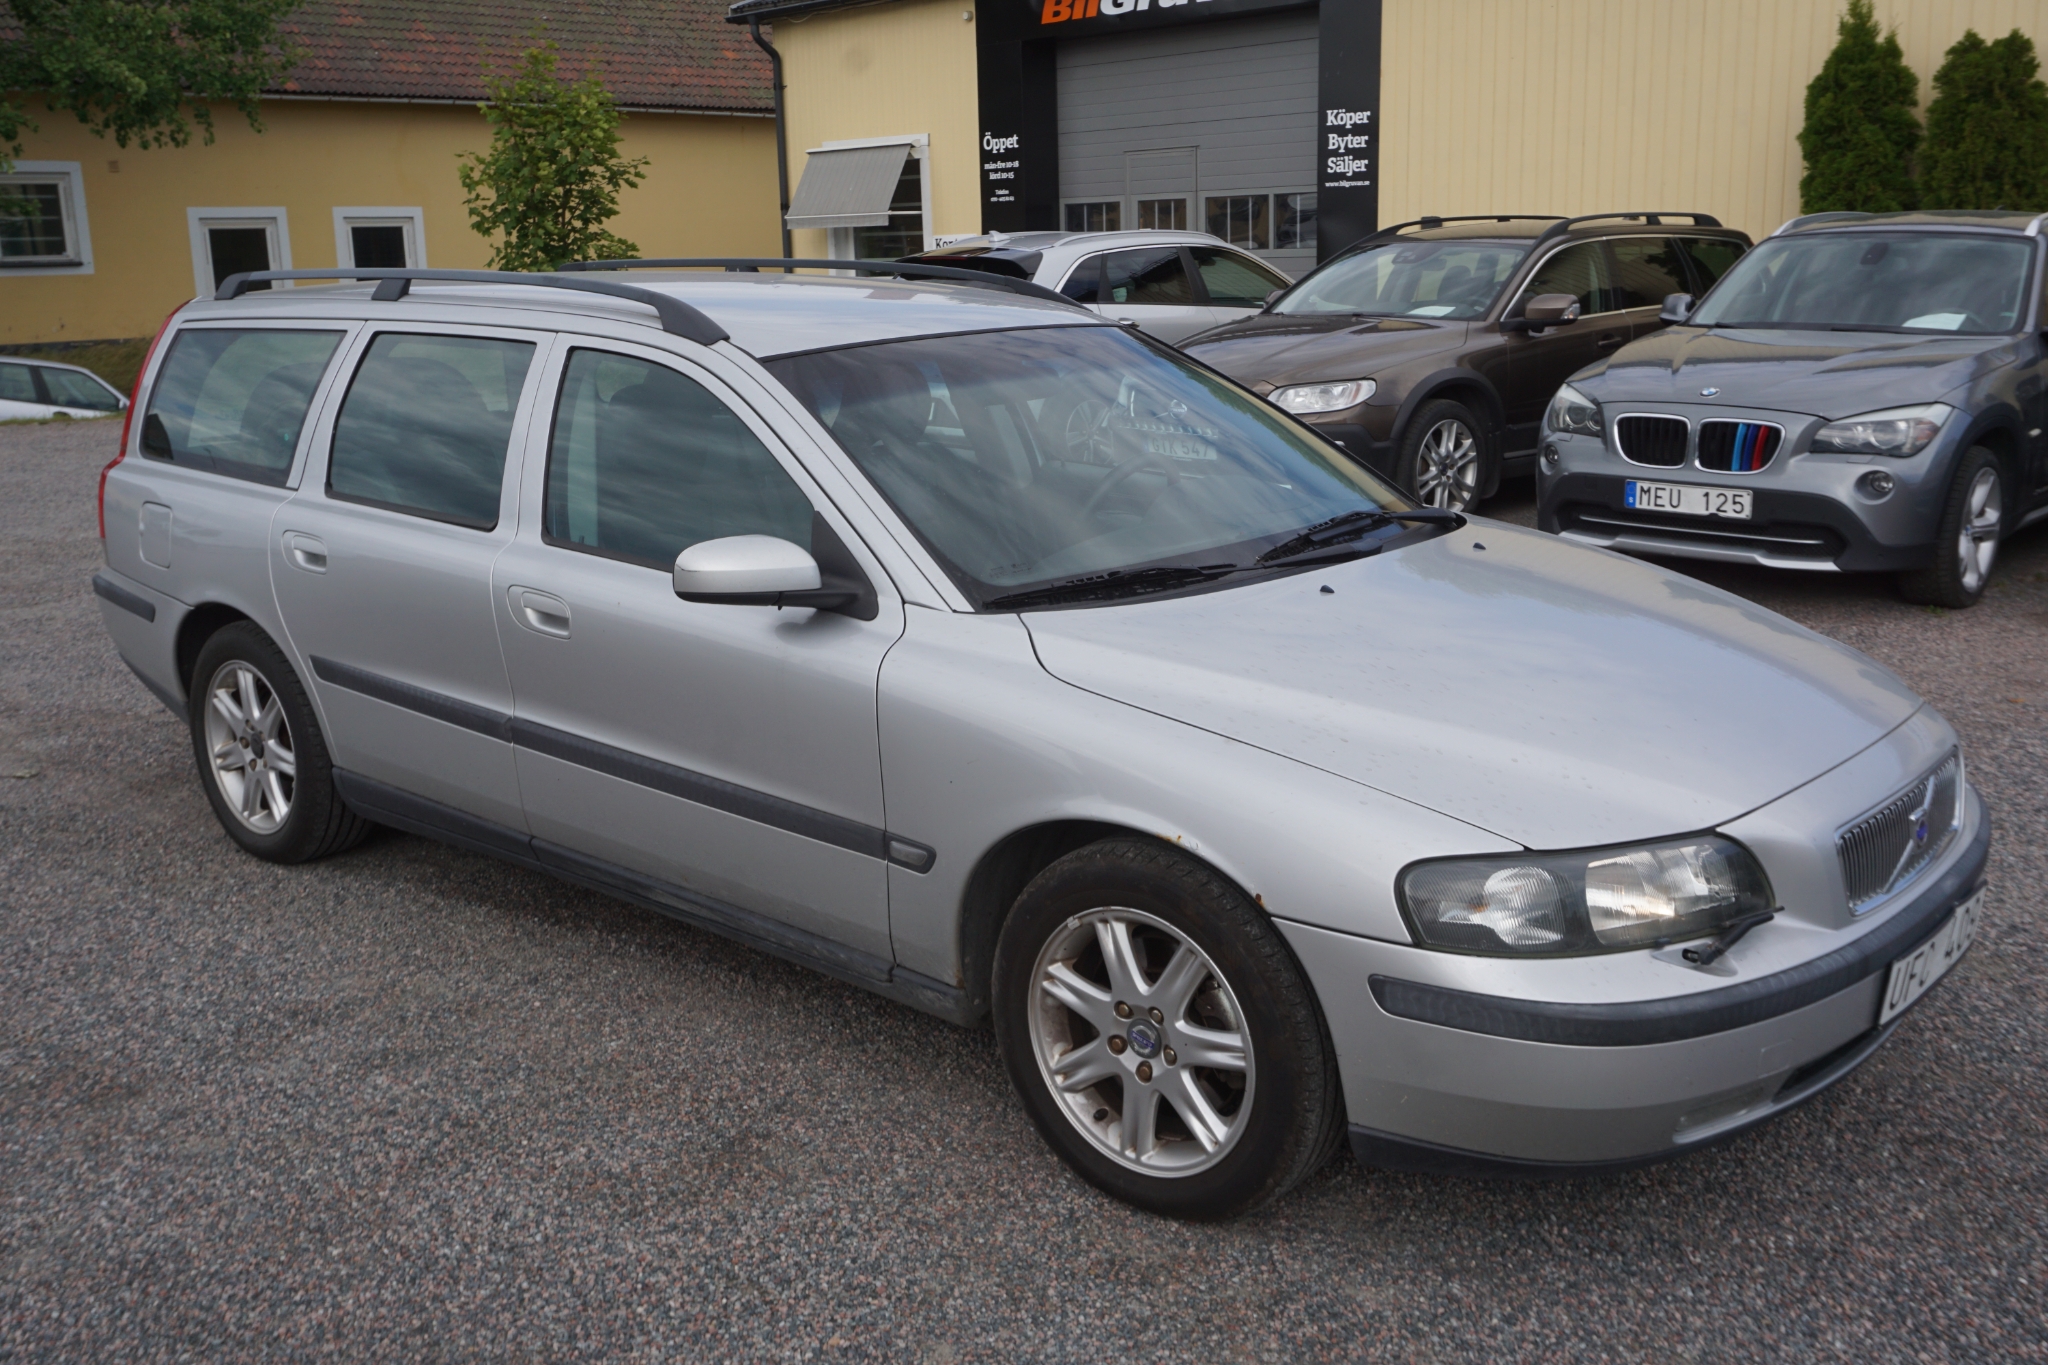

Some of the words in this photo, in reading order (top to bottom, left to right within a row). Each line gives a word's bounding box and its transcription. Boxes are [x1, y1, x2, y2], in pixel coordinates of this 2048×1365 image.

[1326, 109, 1371, 129] Köper
[983, 131, 1019, 154] Öppet
[1327, 133, 1369, 153] Byter
[1327, 155, 1369, 177] Säljer
[1639, 485, 1681, 509] MEU
[1702, 491, 1745, 515] 125
